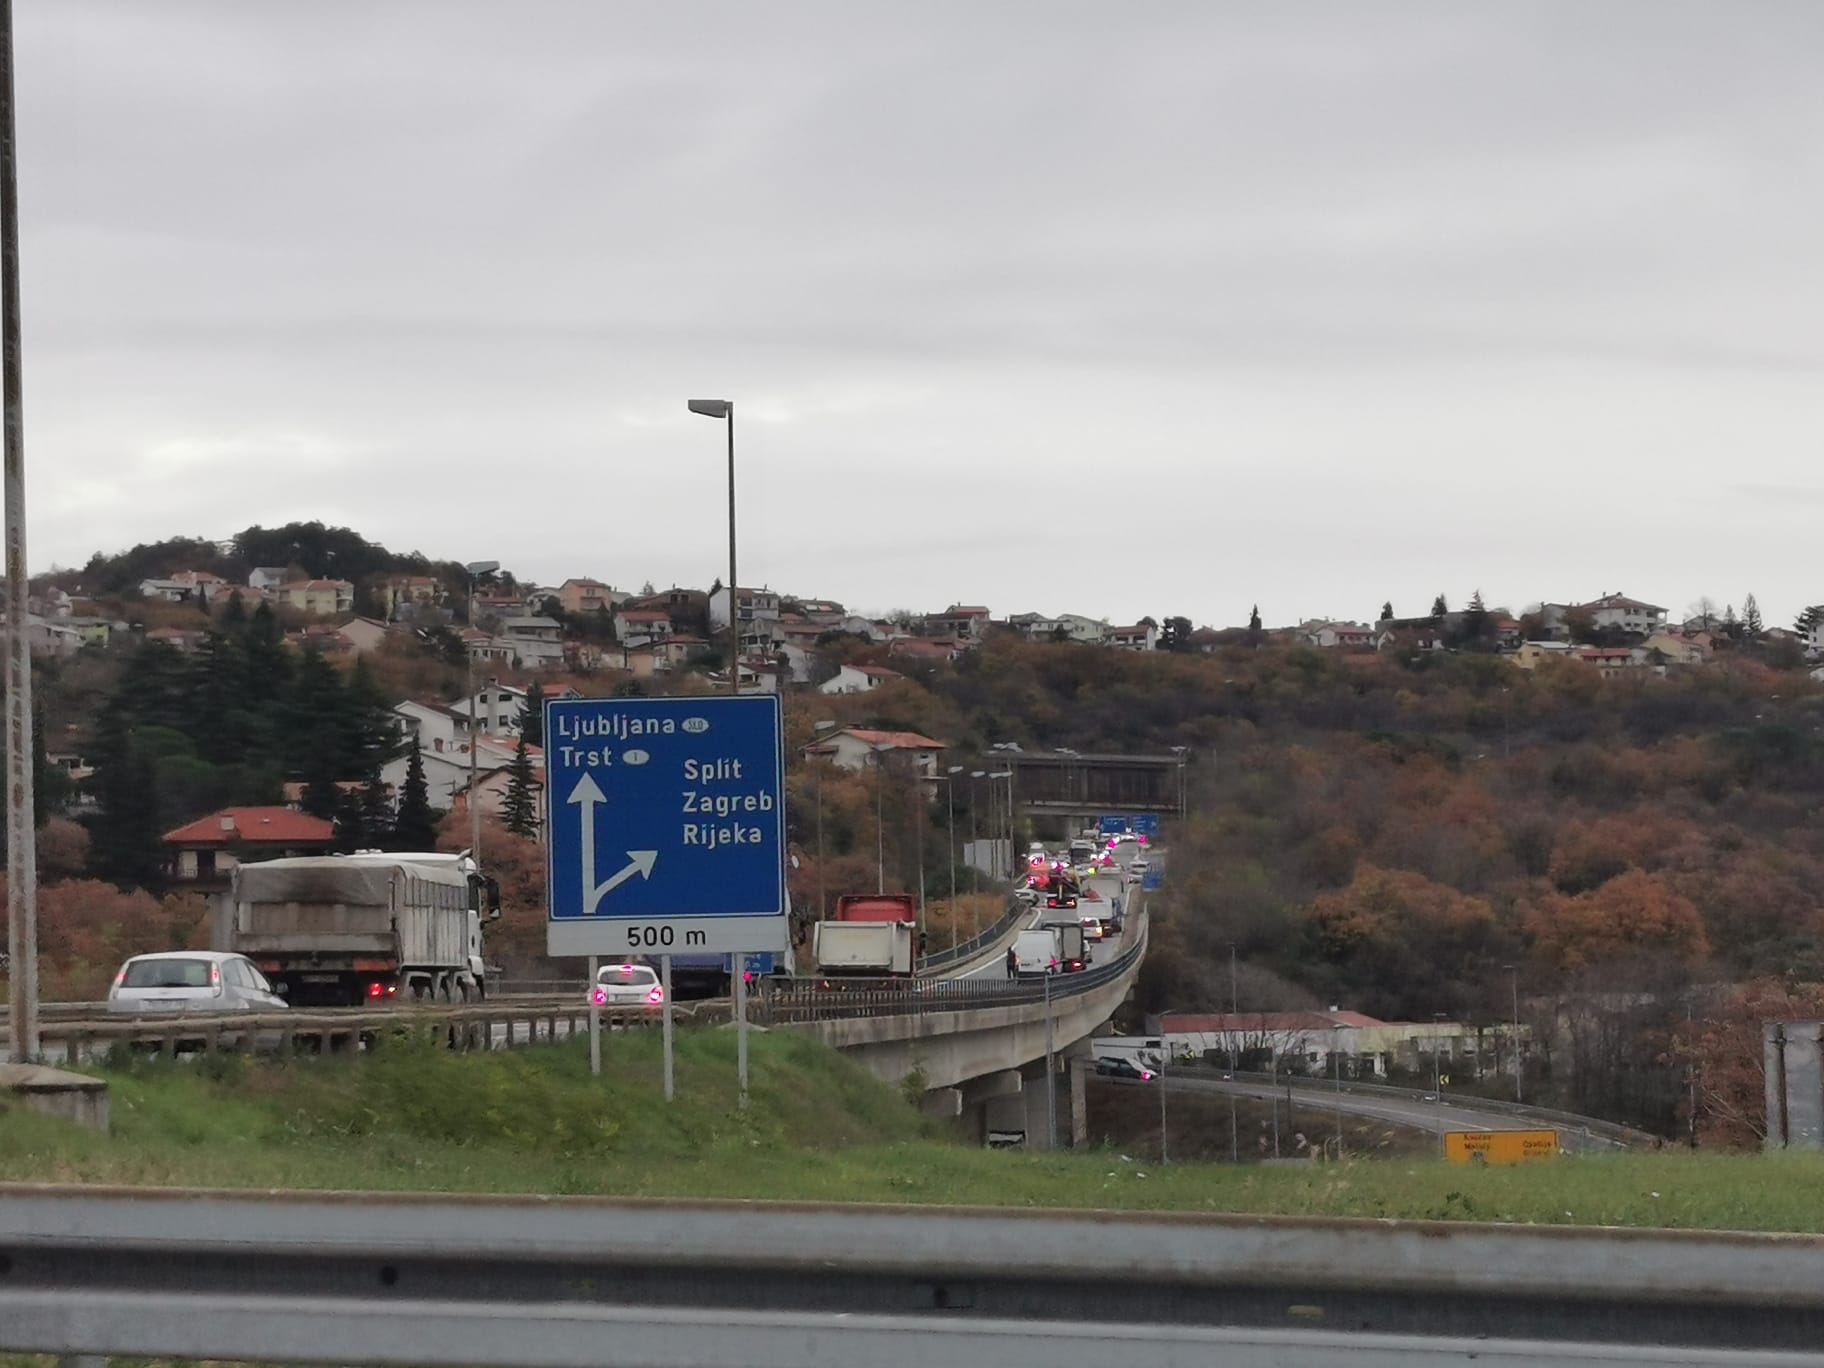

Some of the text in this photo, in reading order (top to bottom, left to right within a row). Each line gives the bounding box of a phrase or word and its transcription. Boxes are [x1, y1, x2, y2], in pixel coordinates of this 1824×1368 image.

[559, 714, 675, 741] Ljubljana
[560, 746, 612, 767] Trst
[684, 758, 742, 785] Split
[682, 789, 772, 817] Zagreb
[683, 822, 762, 849] Rijeka
[627, 925, 706, 947] 500 m
